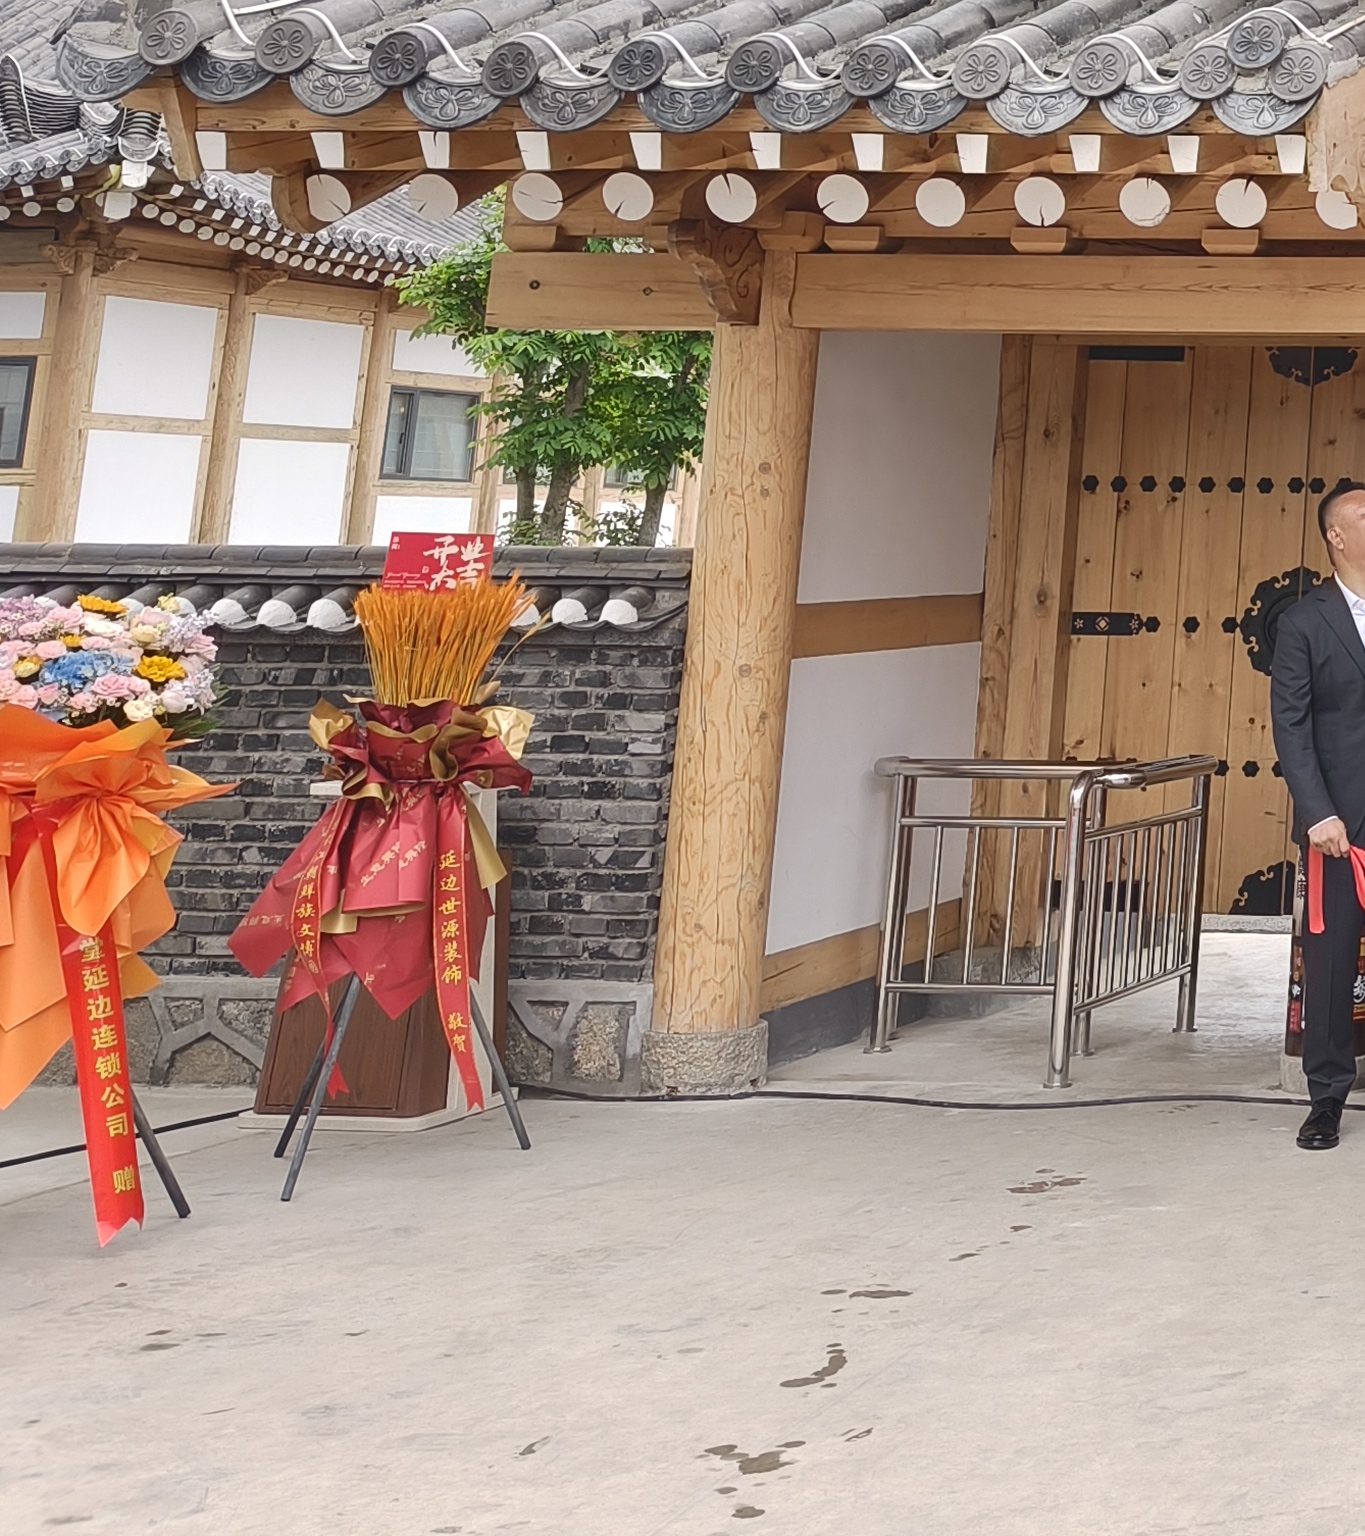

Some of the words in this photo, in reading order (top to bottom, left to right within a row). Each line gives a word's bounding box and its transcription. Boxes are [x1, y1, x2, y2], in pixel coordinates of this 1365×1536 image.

[423, 535, 491, 566] 开业
[438, 850, 463, 985] 延边世源装饰
[447, 1012, 468, 1053] 敬贺
[112, 1164, 136, 1195] 赠
